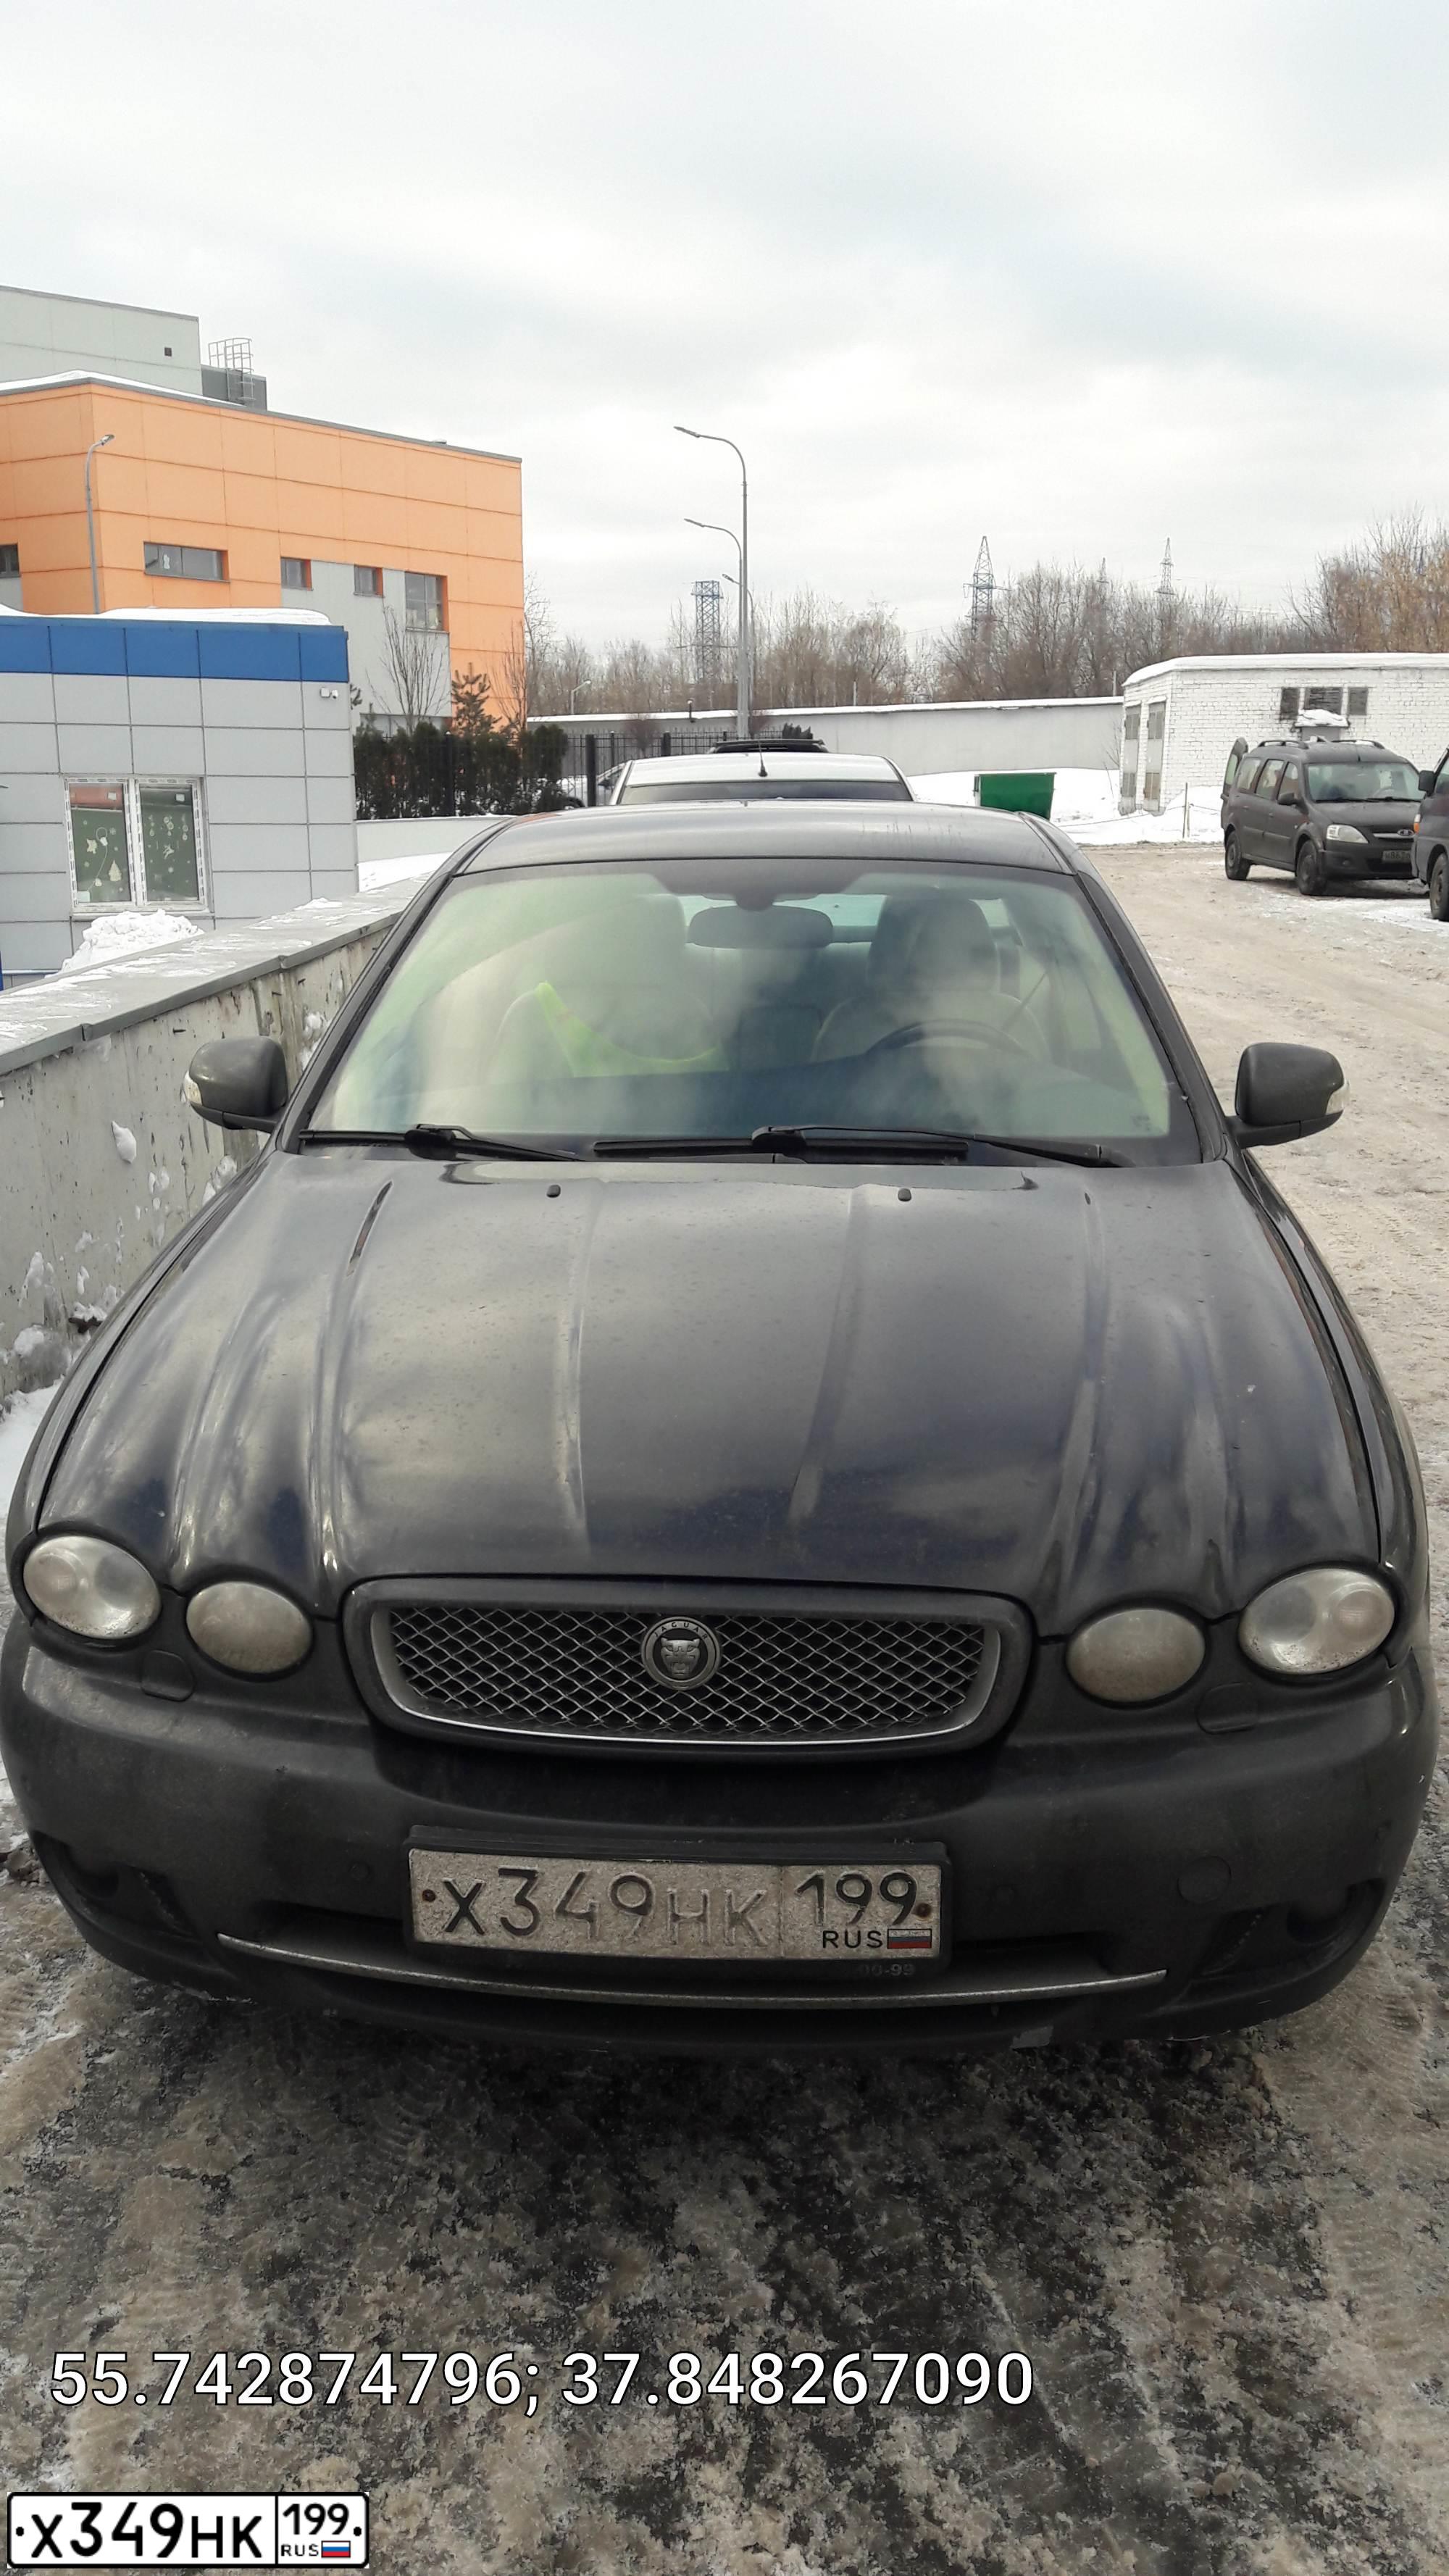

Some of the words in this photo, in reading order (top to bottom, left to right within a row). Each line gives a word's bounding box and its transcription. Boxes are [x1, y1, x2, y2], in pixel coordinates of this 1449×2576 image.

[654, 1622, 708, 1641] JAGUAR
[795, 1870, 919, 1927] 199
[822, 1928, 883, 1949] RUS
